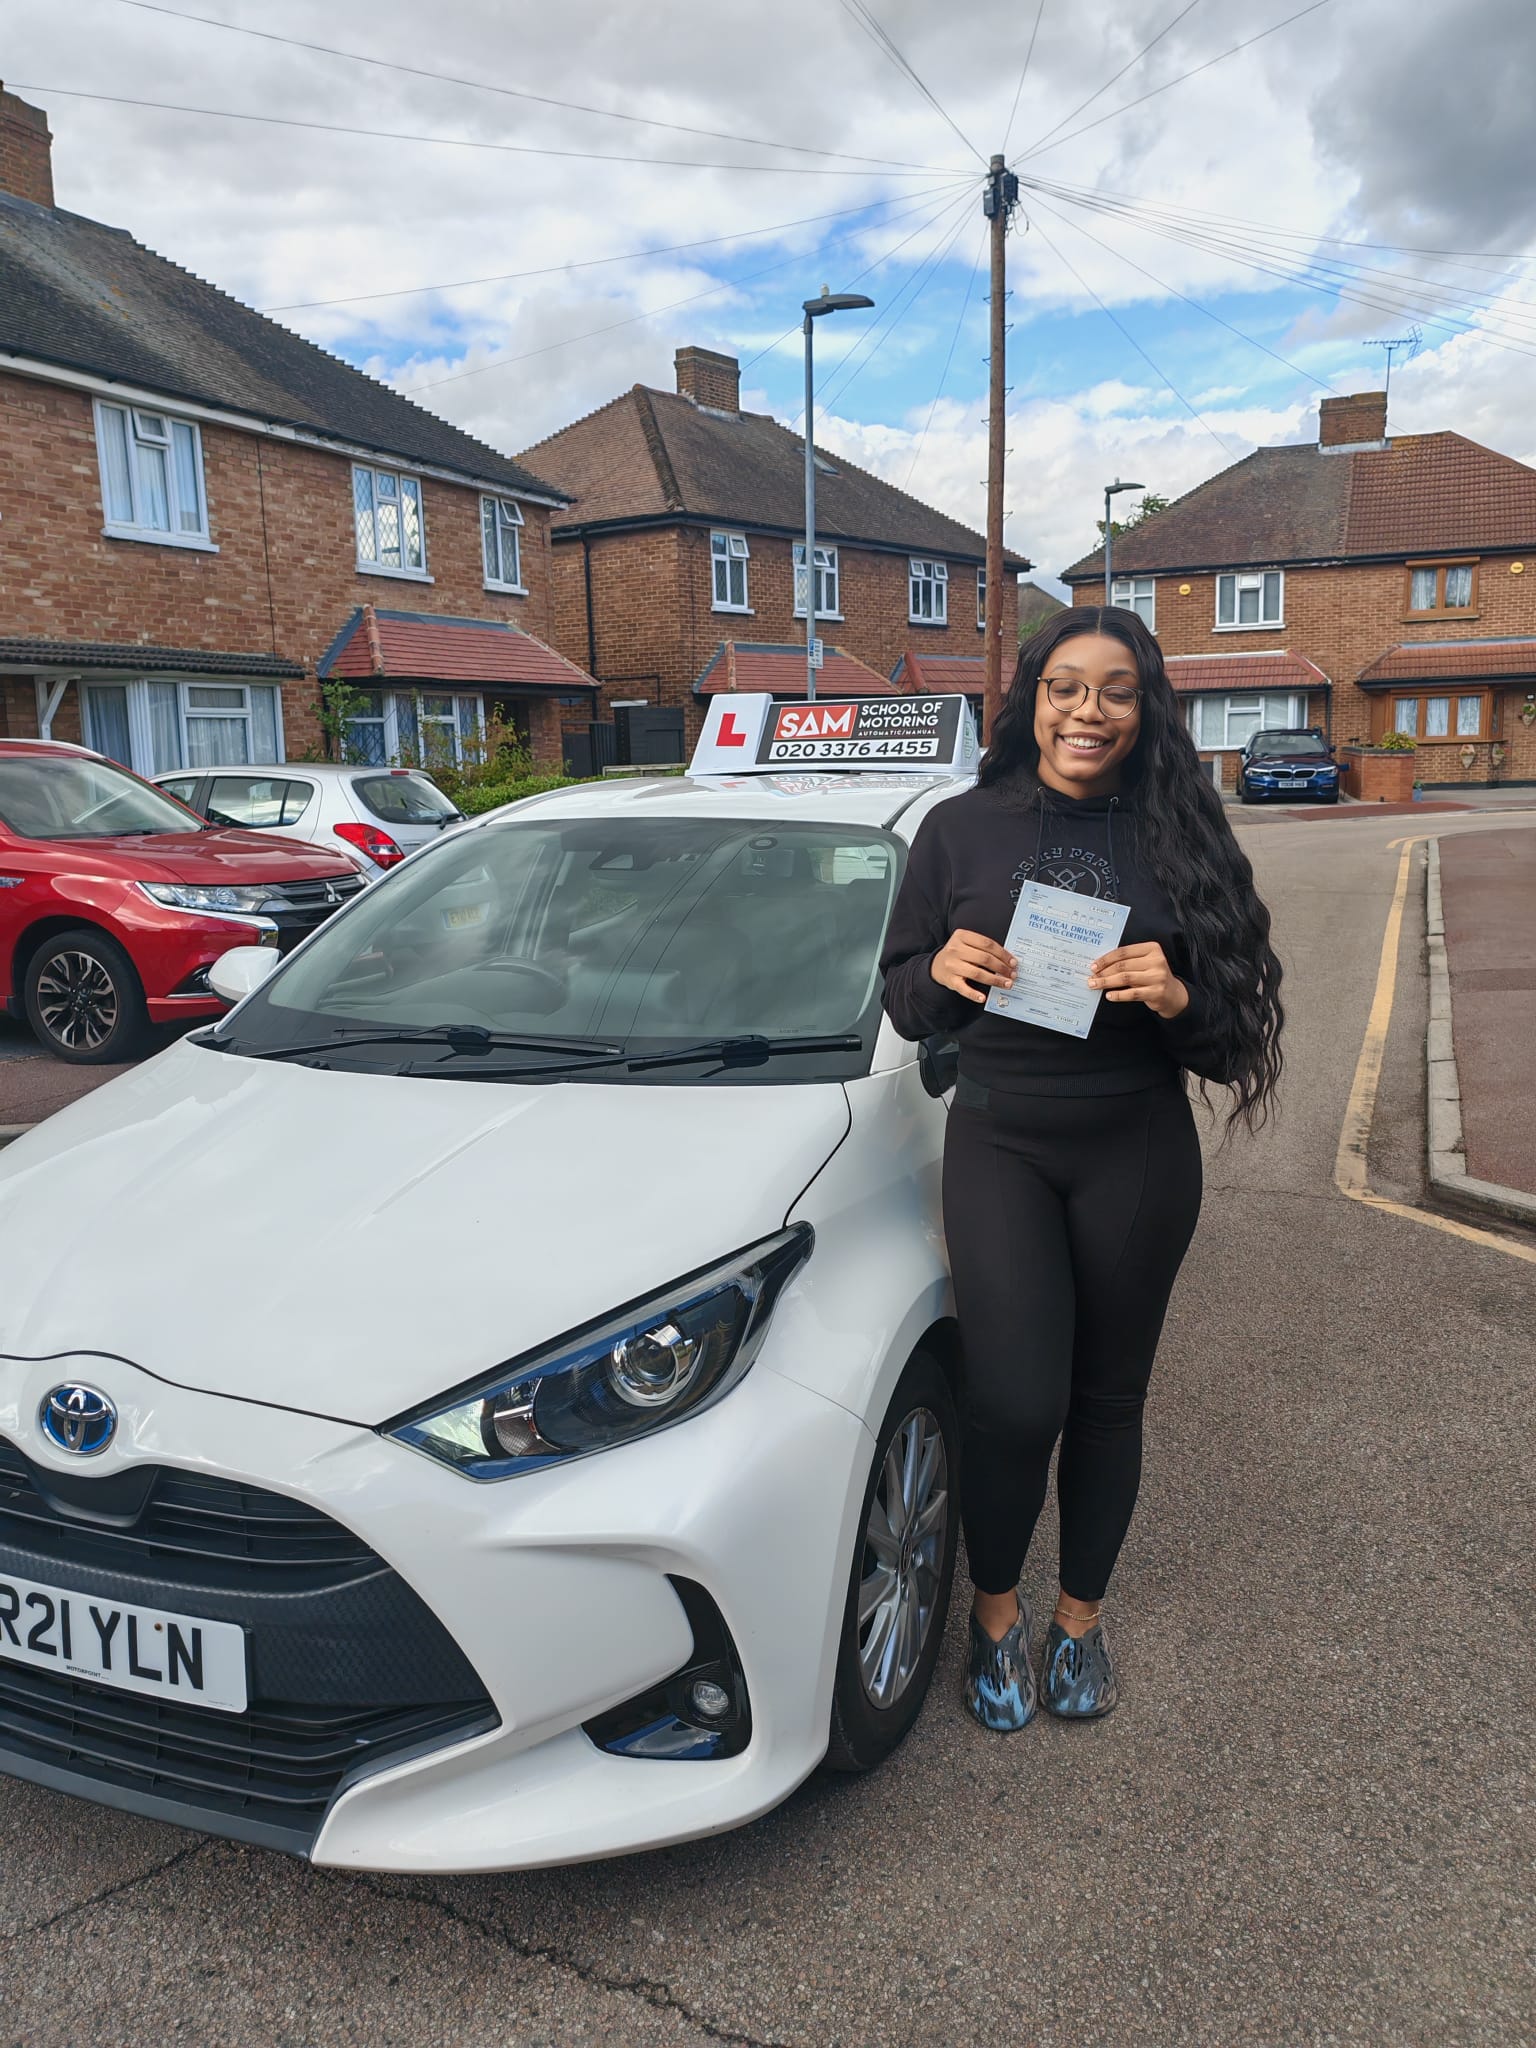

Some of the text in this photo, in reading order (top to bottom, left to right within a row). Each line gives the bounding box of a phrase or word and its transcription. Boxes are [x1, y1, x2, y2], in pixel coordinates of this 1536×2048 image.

[859, 715, 939, 729] MOTORING
[861, 701, 943, 717] SCHOOL OF
[716, 713, 746, 746] L
[780, 708, 851, 737] SAM
[858, 729, 936, 737] AUTOMATIC/MANUAL
[776, 740, 932, 758] 020 3376 4455
[1028, 920, 1044, 929] TEST
[1044, 925, 1060, 935] PASS
[1061, 930, 1102, 946] CERTIFICATE
[1029, 913, 1104, 939] PRACTICAL DRIVING
[89, 1605, 204, 1690] YLN
